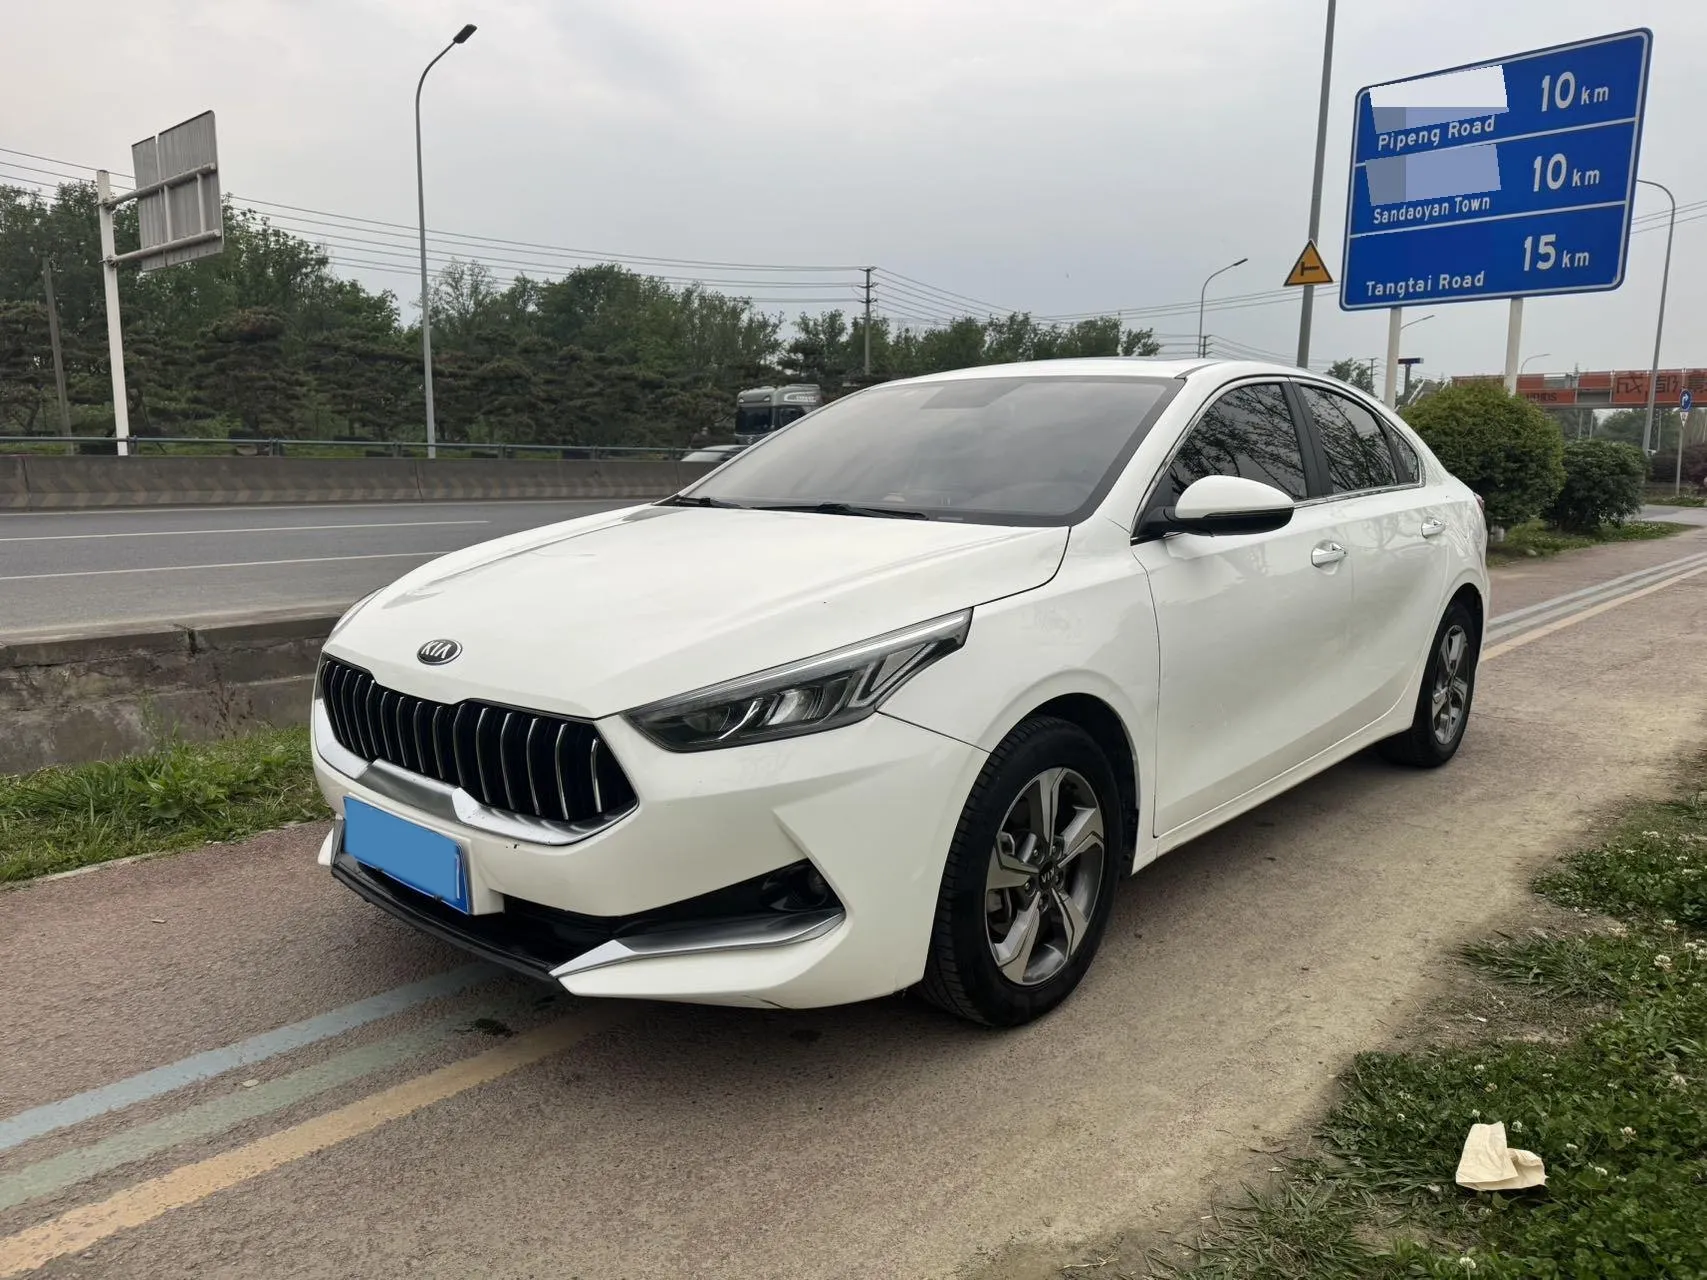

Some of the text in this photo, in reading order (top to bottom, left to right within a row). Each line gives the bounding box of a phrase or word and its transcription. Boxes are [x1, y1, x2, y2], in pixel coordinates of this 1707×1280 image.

[1541, 71, 1609, 112] 10 km
[1377, 114, 1496, 151] Pipeng Road
[1533, 153, 1600, 192] 10 km
[1373, 196, 1490, 224] Sandaoyan Town
[1523, 233, 1589, 271] 15 km
[1366, 270, 1485, 298] Tangtai Road
[420, 641, 453, 659] KIA
